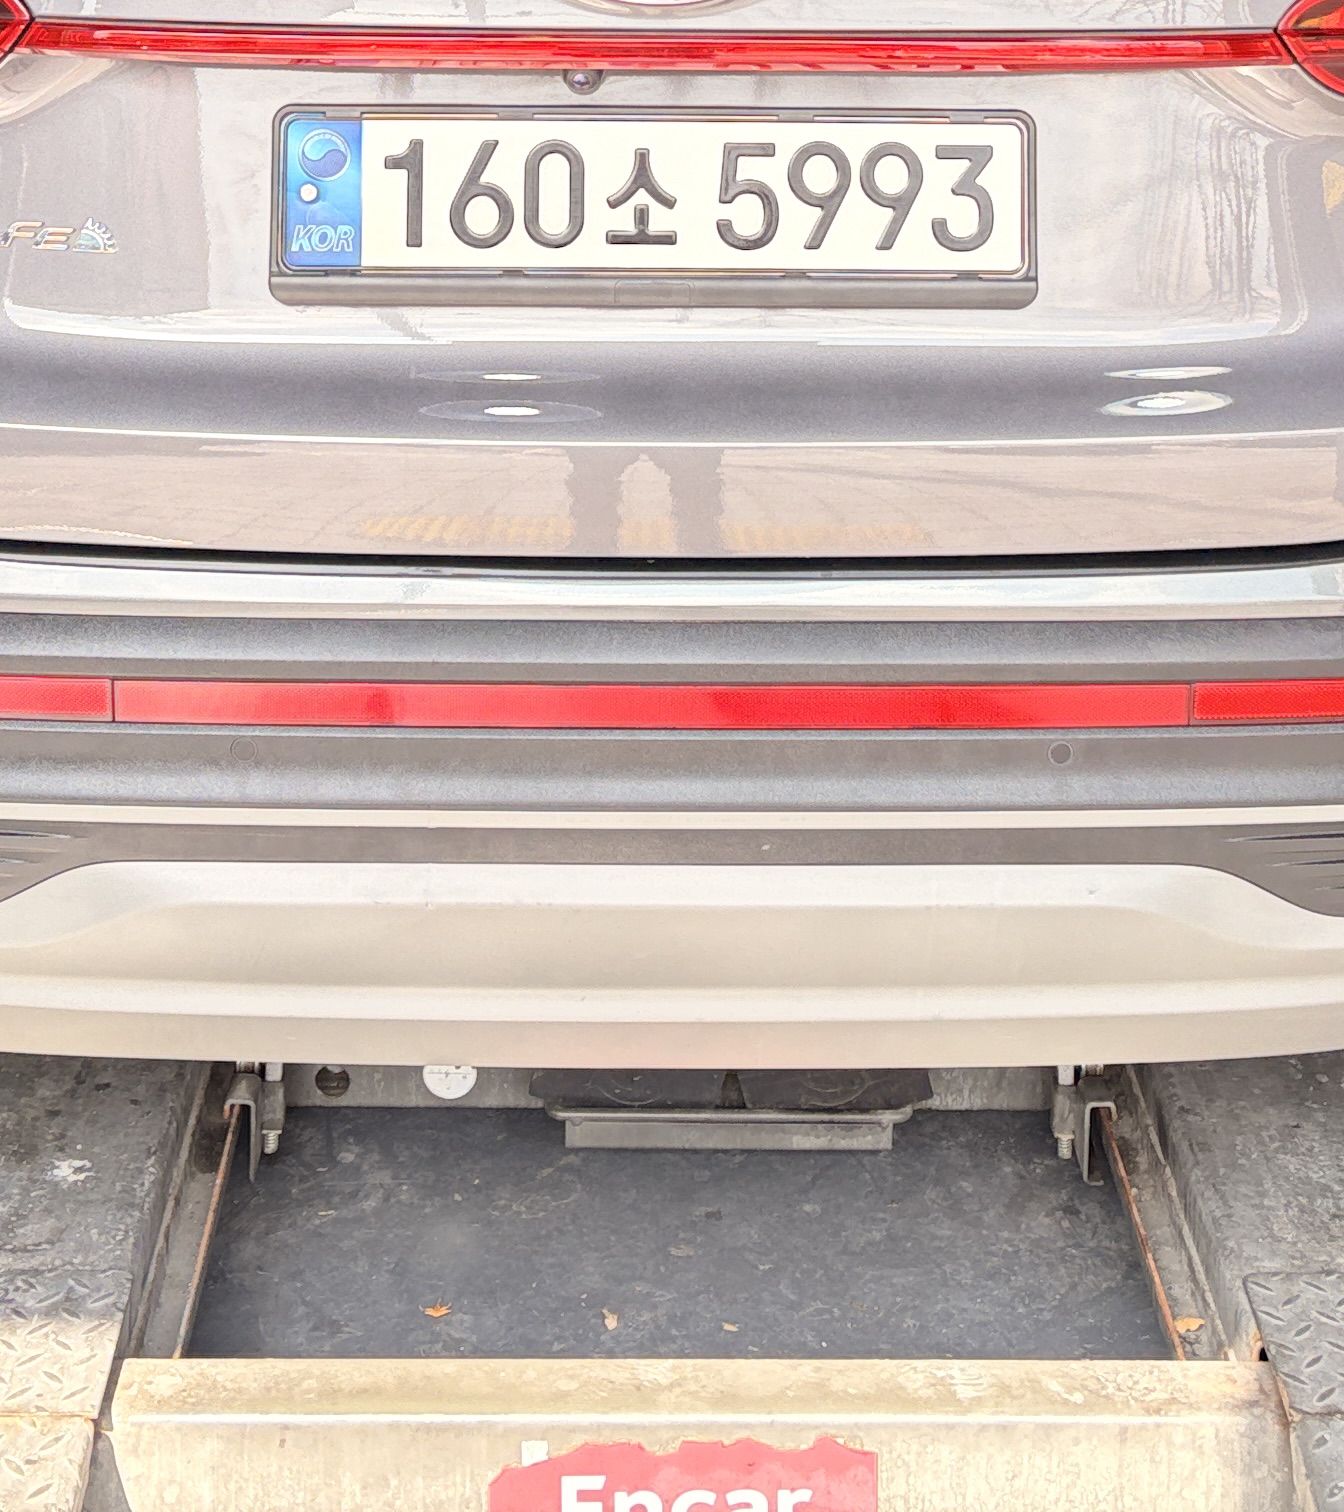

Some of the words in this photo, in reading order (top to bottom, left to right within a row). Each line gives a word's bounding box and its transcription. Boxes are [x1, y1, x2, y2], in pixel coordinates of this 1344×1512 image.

[384, 139, 677, 250] 160소
[716, 141, 994, 252] 5993
[0, 221, 76, 251] FE
[291, 225, 355, 252] KOR
